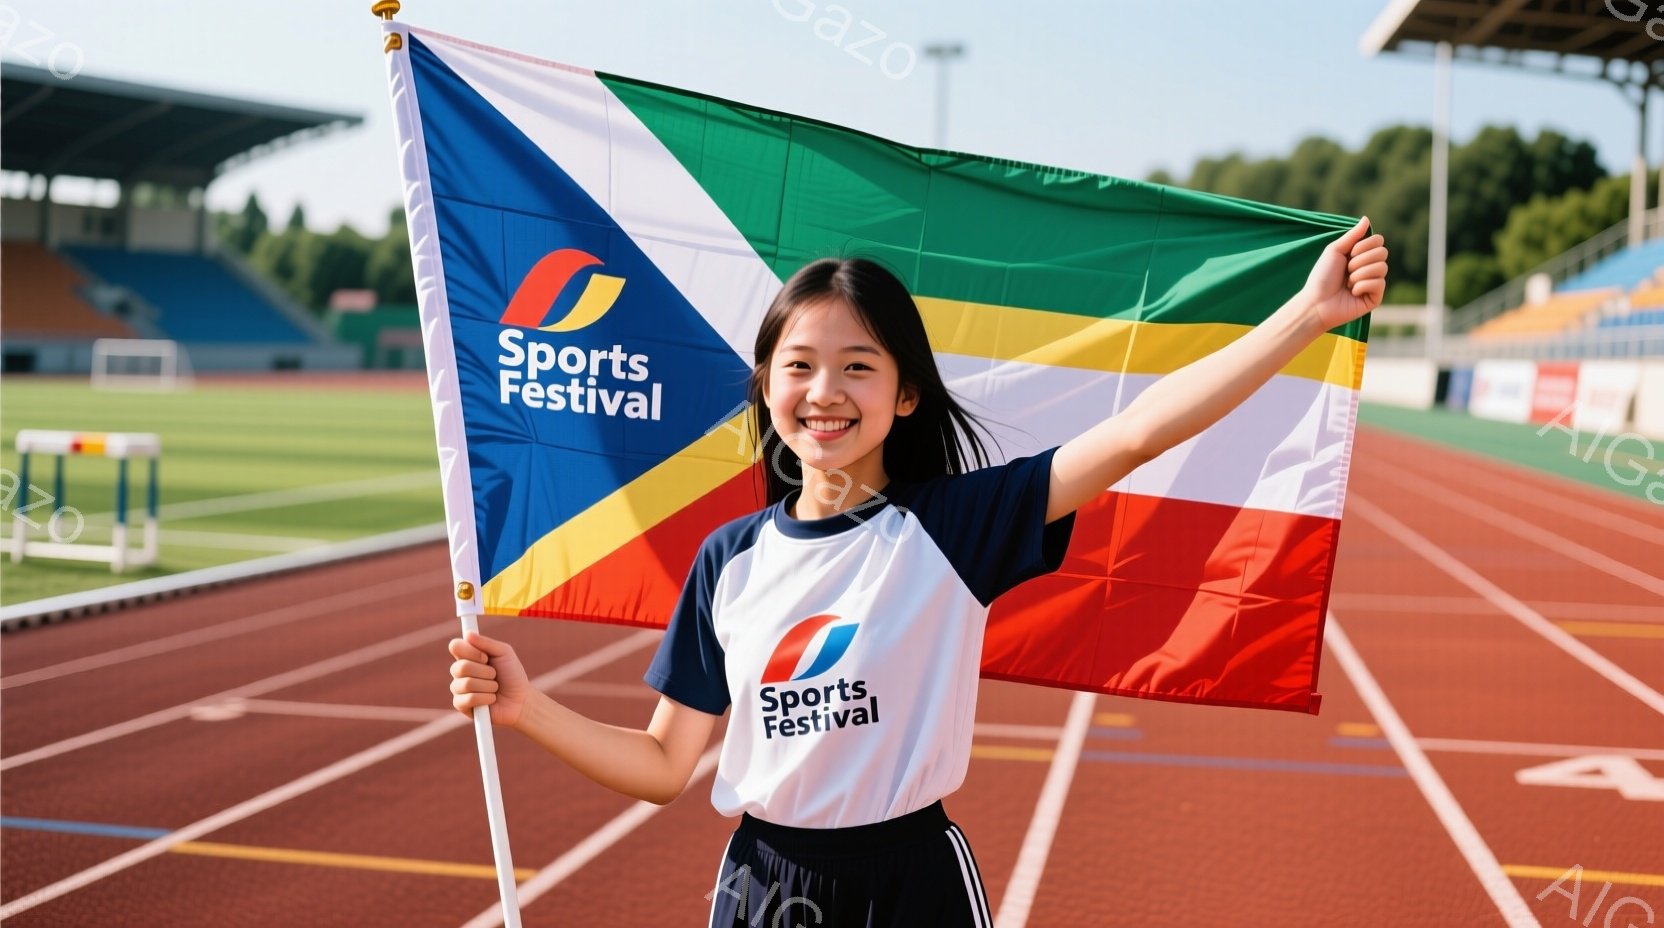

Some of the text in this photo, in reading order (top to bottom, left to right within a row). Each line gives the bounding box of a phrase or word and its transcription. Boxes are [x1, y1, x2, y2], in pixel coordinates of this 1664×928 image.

[498, 328, 649, 382] Sports
[499, 369, 663, 421] Festival
[759, 678, 868, 717] Sports
[763, 696, 880, 739] Festival
